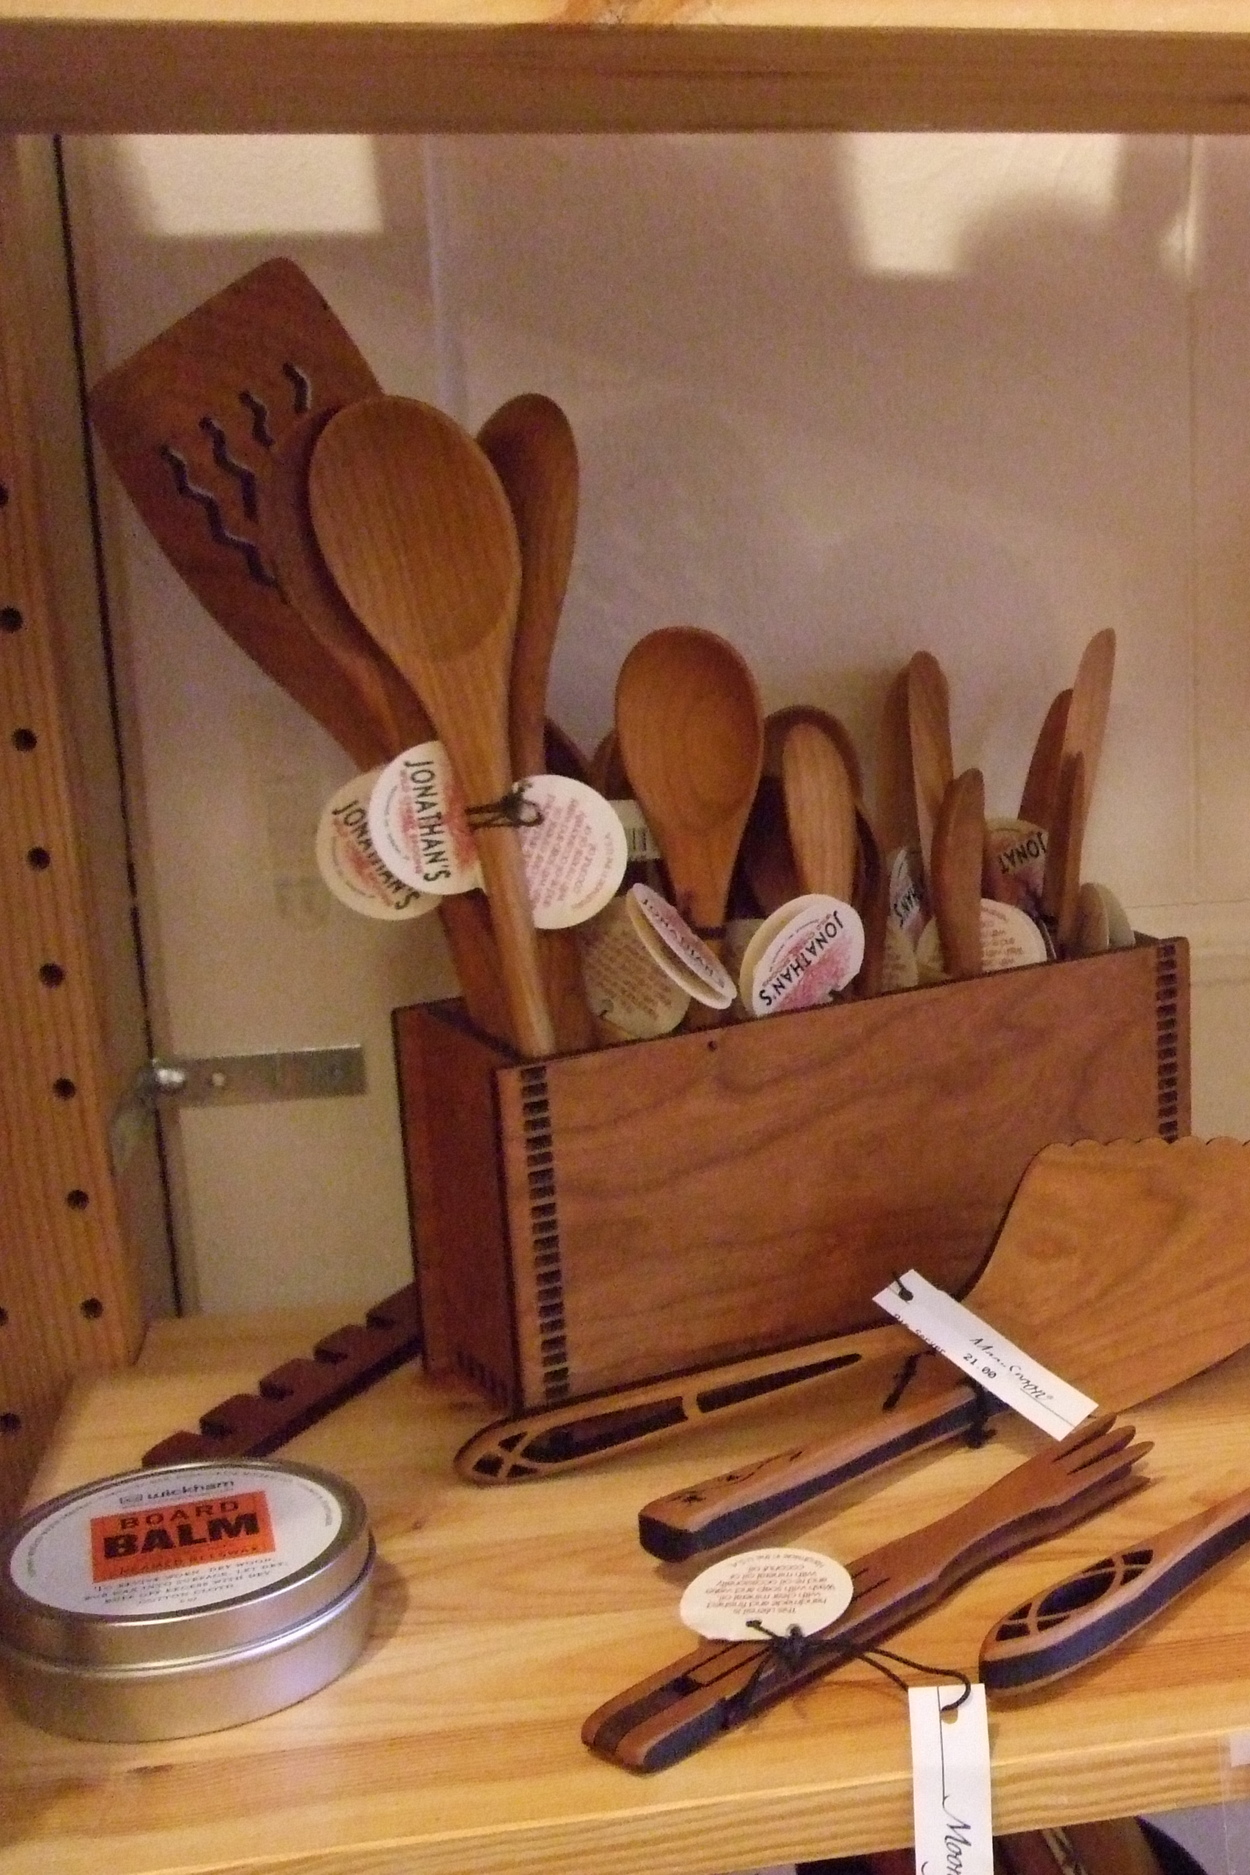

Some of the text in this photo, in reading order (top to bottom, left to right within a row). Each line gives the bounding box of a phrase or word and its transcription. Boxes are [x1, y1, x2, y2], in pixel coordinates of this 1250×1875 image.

[404, 760, 451, 882] JONATHAN'S
[998, 831, 1047, 874] JONAT
[759, 910, 844, 1006] JONATHAN'S
[963, 1353, 997, 1379] 21.00
[104, 1512, 260, 1559] BALM
[120, 1501, 239, 1530] BOARD
